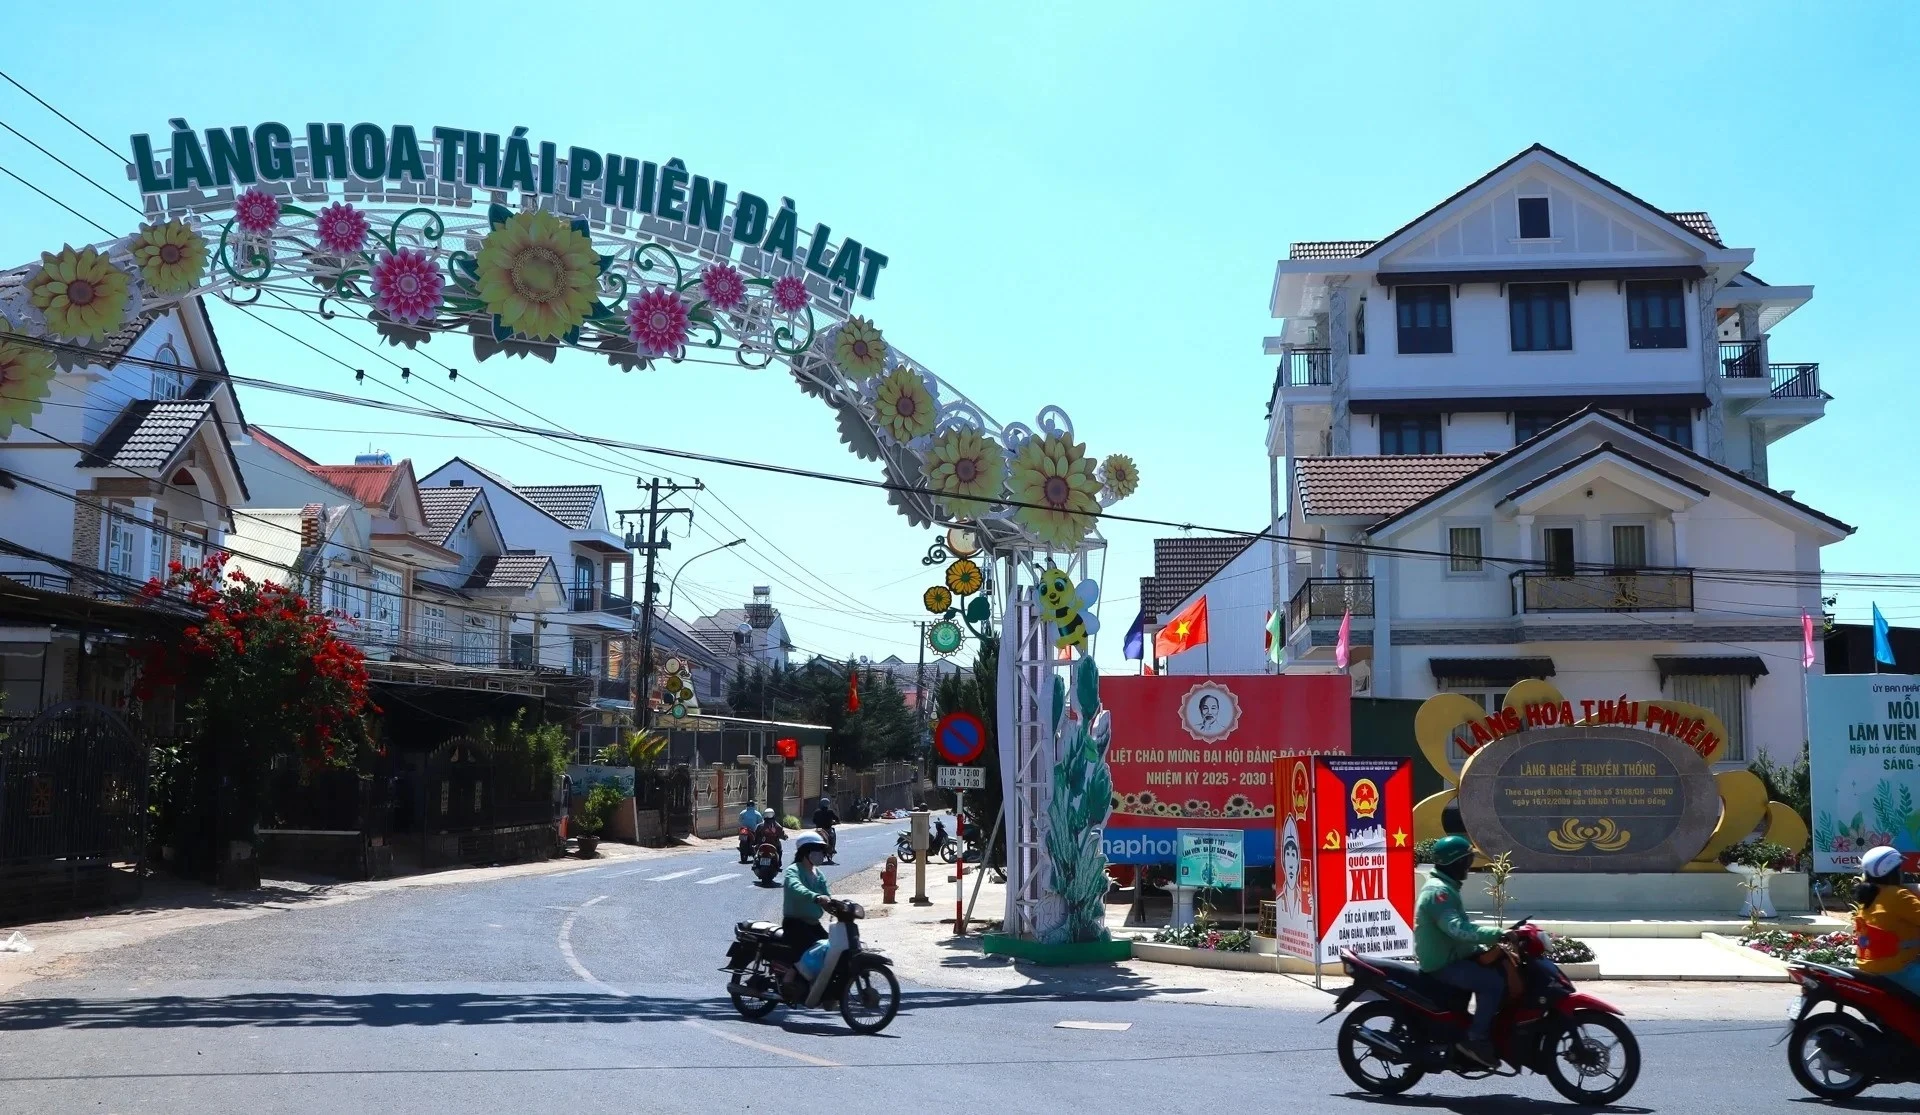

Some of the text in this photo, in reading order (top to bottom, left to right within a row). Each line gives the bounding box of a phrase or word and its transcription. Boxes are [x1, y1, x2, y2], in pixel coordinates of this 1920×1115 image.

[130, 118, 889, 300] LÀNG HOA THÁI PHIÊN ĐÀ LẠT
[1887, 694, 1920, 720] MỖI
[1455, 706, 1521, 755] LÀNG
[1525, 700, 1575, 727] HOA
[1580, 693, 1639, 726] THÁI
[1849, 722, 1917, 741] LÂM VIÊN
[1110, 747, 1133, 766] LIỆT
[1135, 747, 1165, 763] CHÀO
[1167, 747, 1200, 763] MỪNG
[1203, 749, 1222, 766] ĐẠI
[1225, 747, 1244, 766] HỘI
[1850, 744, 1866, 756] Hãy
[1869, 743, 1880, 754] bỏ
[1882, 744, 1897, 754] rác
[941, 767, 957, 776] 11:00
[963, 768, 980, 777] 12:00
[1520, 758, 1657, 776] LÀNG NGHỀ TRUYỀN THỐNG
[1883, 756, 1914, 770] SÁNG
[963, 778, 980, 787] 17:30
[1146, 769, 1182, 788] NHIỆM
[1185, 769, 1199, 785] KỲ
[1202, 772, 1229, 785] 2025
[1239, 772, 1267, 785] 2030
[1348, 852, 1385, 868] QUỐC HỘI
[1349, 868, 1385, 901] XVI
[1344, 908, 1391, 924] TẤT CẢ VÌ MỤC TIÊU
[1339, 927, 1350, 940] DÂN
[1365, 922, 1379, 937] NƯỚC
[1328, 943, 1339, 956] DÂN
[1383, 939, 1393, 951] VĂN
